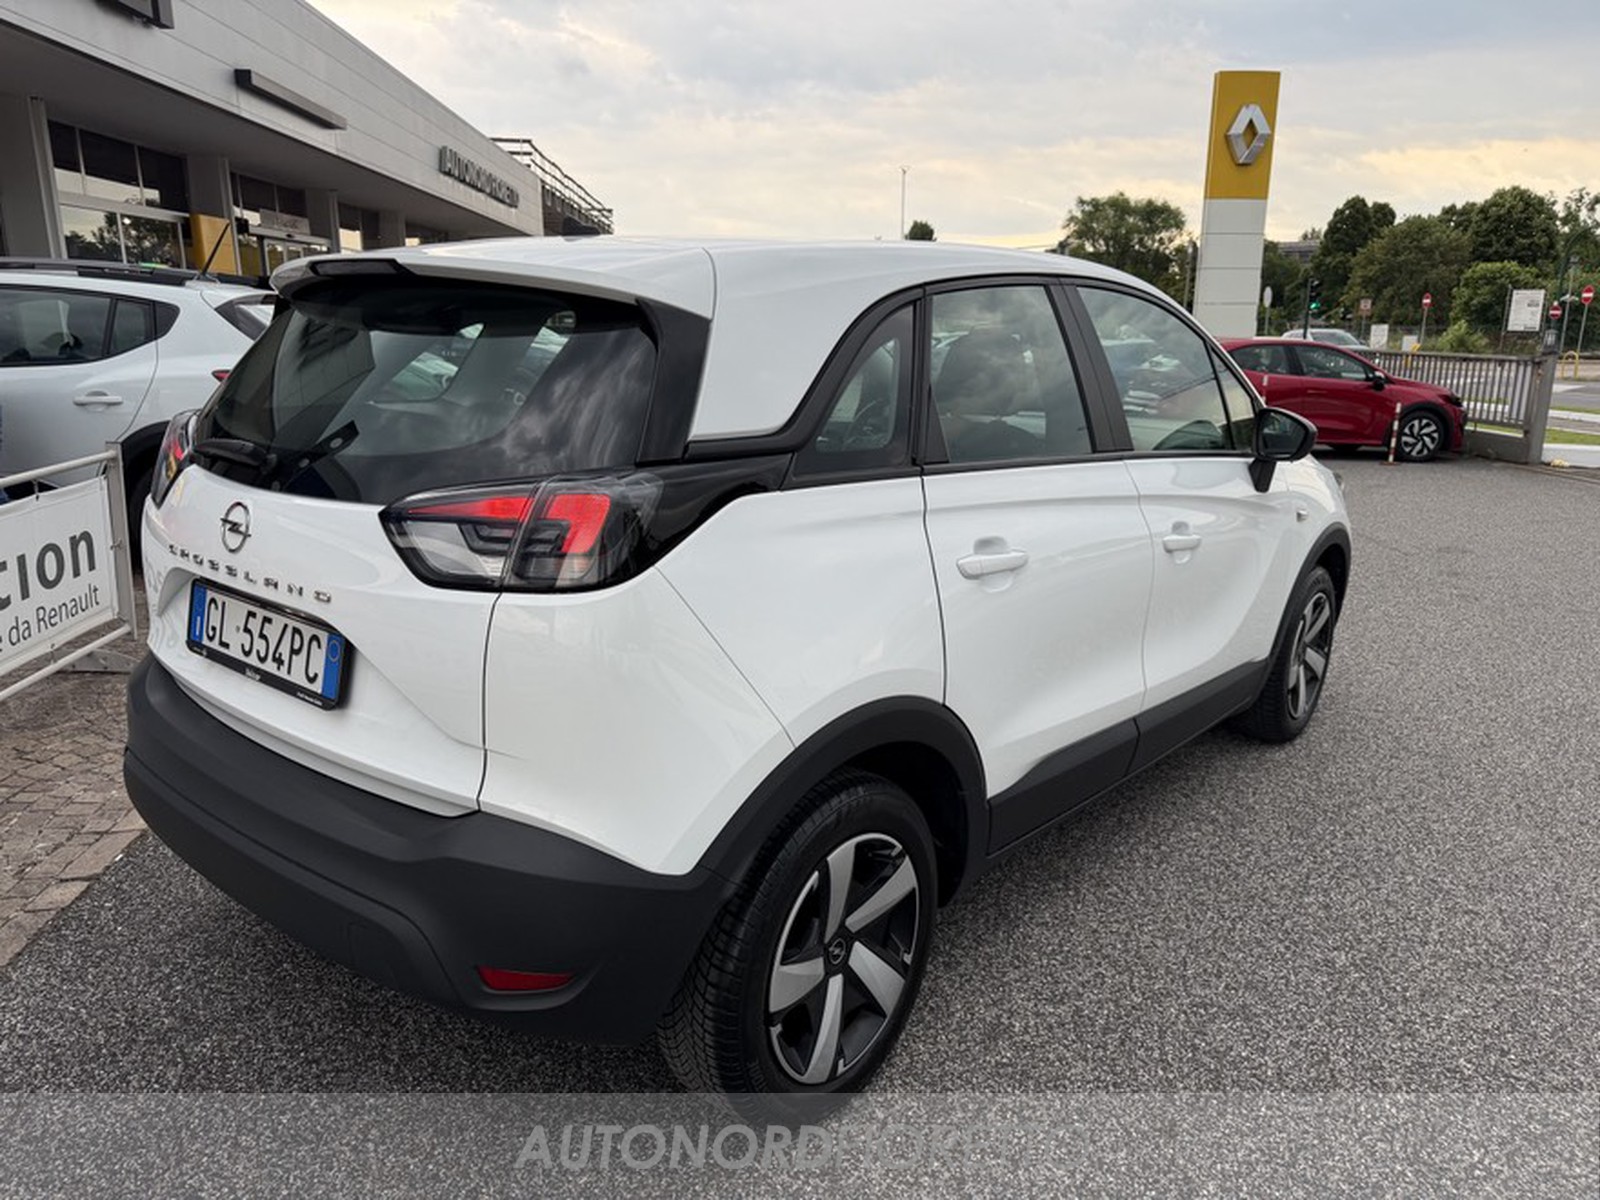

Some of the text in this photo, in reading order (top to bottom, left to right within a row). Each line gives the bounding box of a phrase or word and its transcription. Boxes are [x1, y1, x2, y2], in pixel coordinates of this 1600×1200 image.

[168, 544, 332, 603] CROSSLAND
[8, 615, 32, 646] da
[36, 583, 100, 633] Renault
